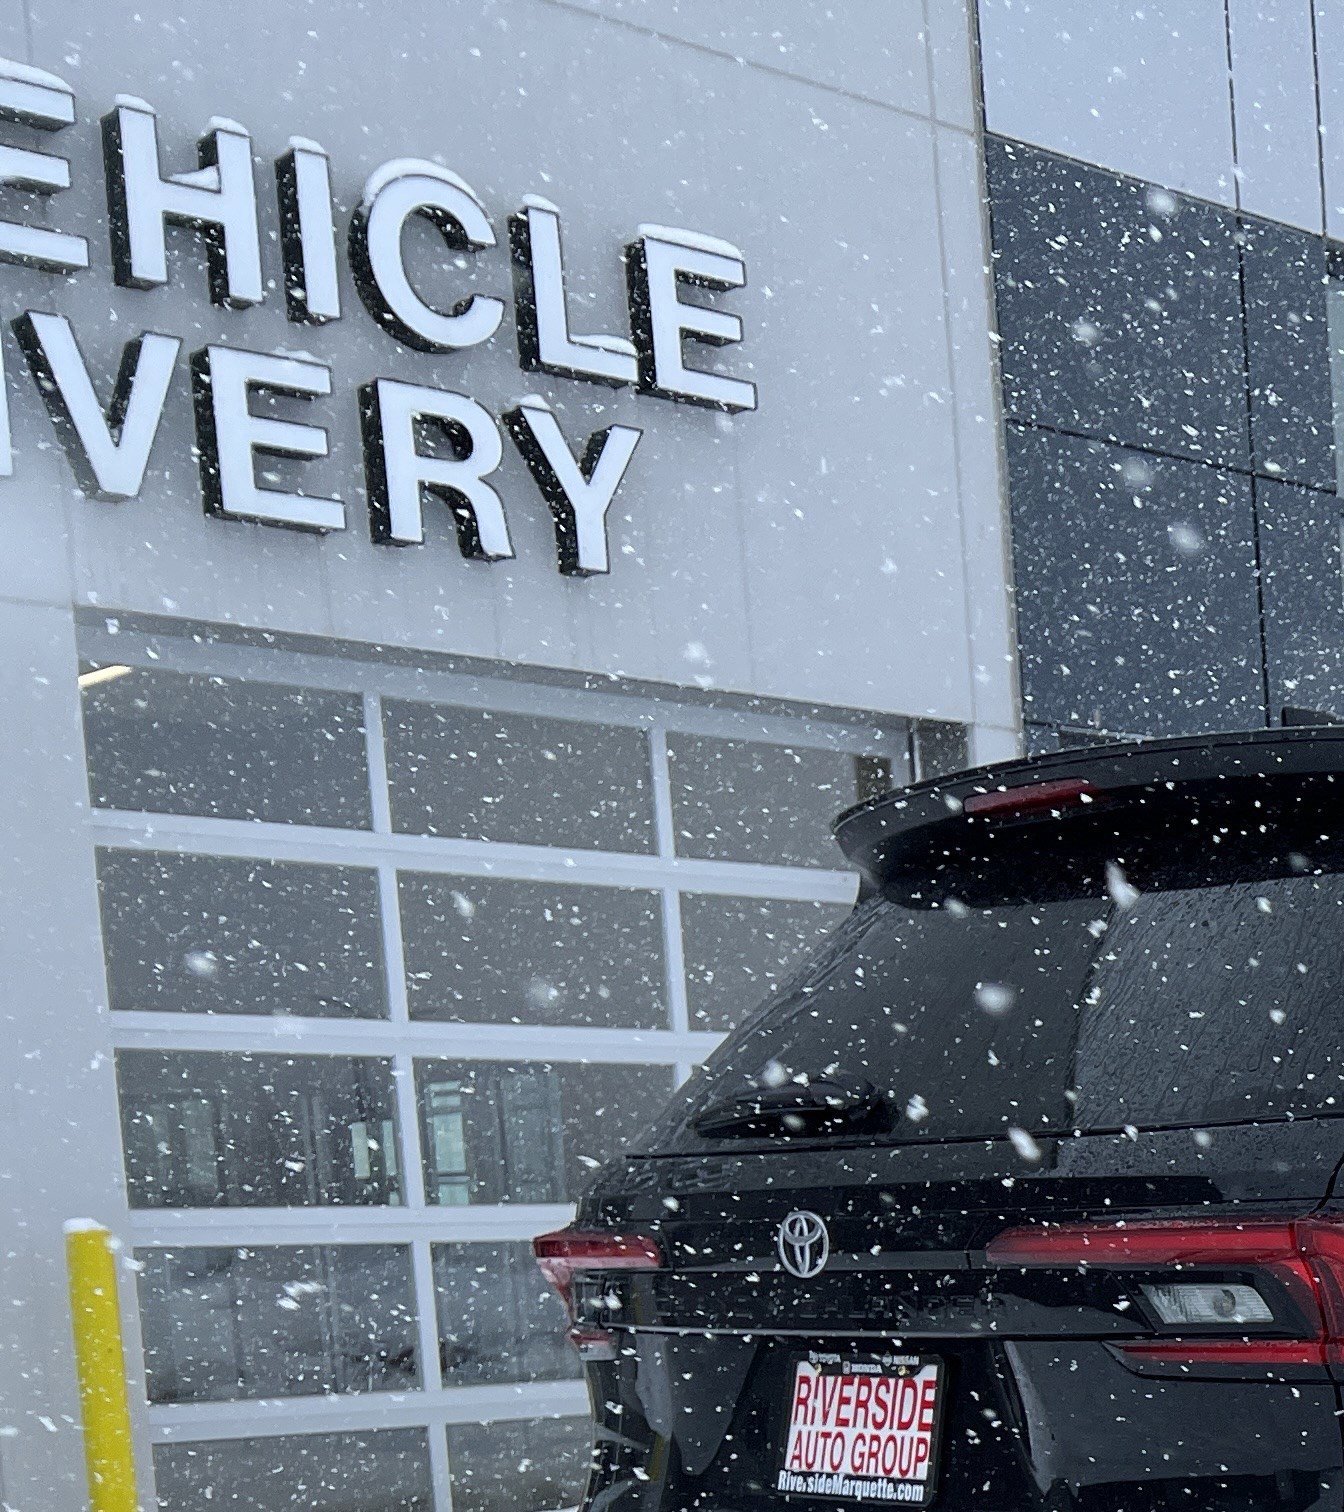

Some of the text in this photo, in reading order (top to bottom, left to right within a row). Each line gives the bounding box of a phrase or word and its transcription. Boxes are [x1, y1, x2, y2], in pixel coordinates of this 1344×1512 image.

[0, 310, 643, 578] VERY
[793, 1375, 937, 1432] RIVERSIDE
[790, 1431, 929, 1478] AUTO GROUP
